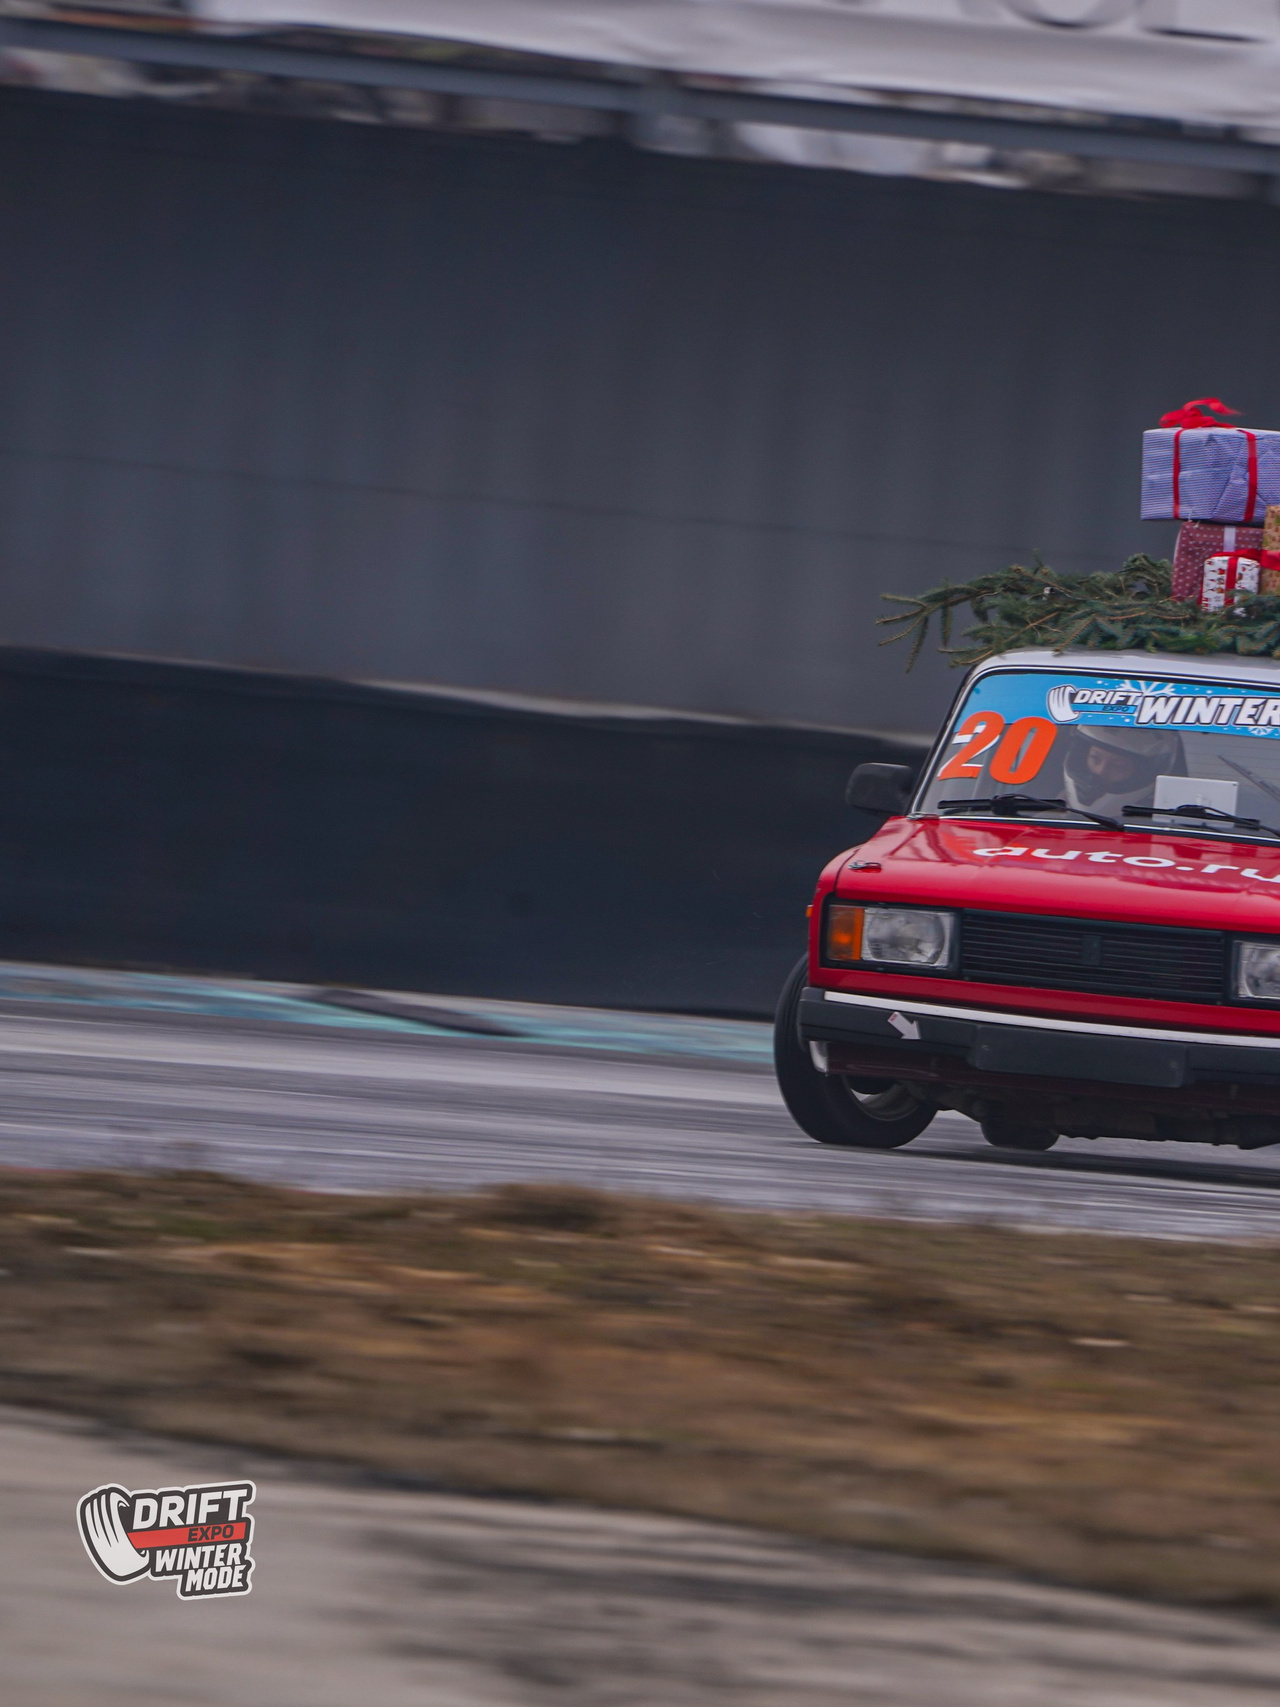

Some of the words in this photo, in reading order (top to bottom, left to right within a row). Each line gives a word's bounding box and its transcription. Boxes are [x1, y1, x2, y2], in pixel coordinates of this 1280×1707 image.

[1073, 689, 1143, 706] DRIFT
[1101, 704, 1130, 712] EXPO
[937, 710, 1058, 785] 20
